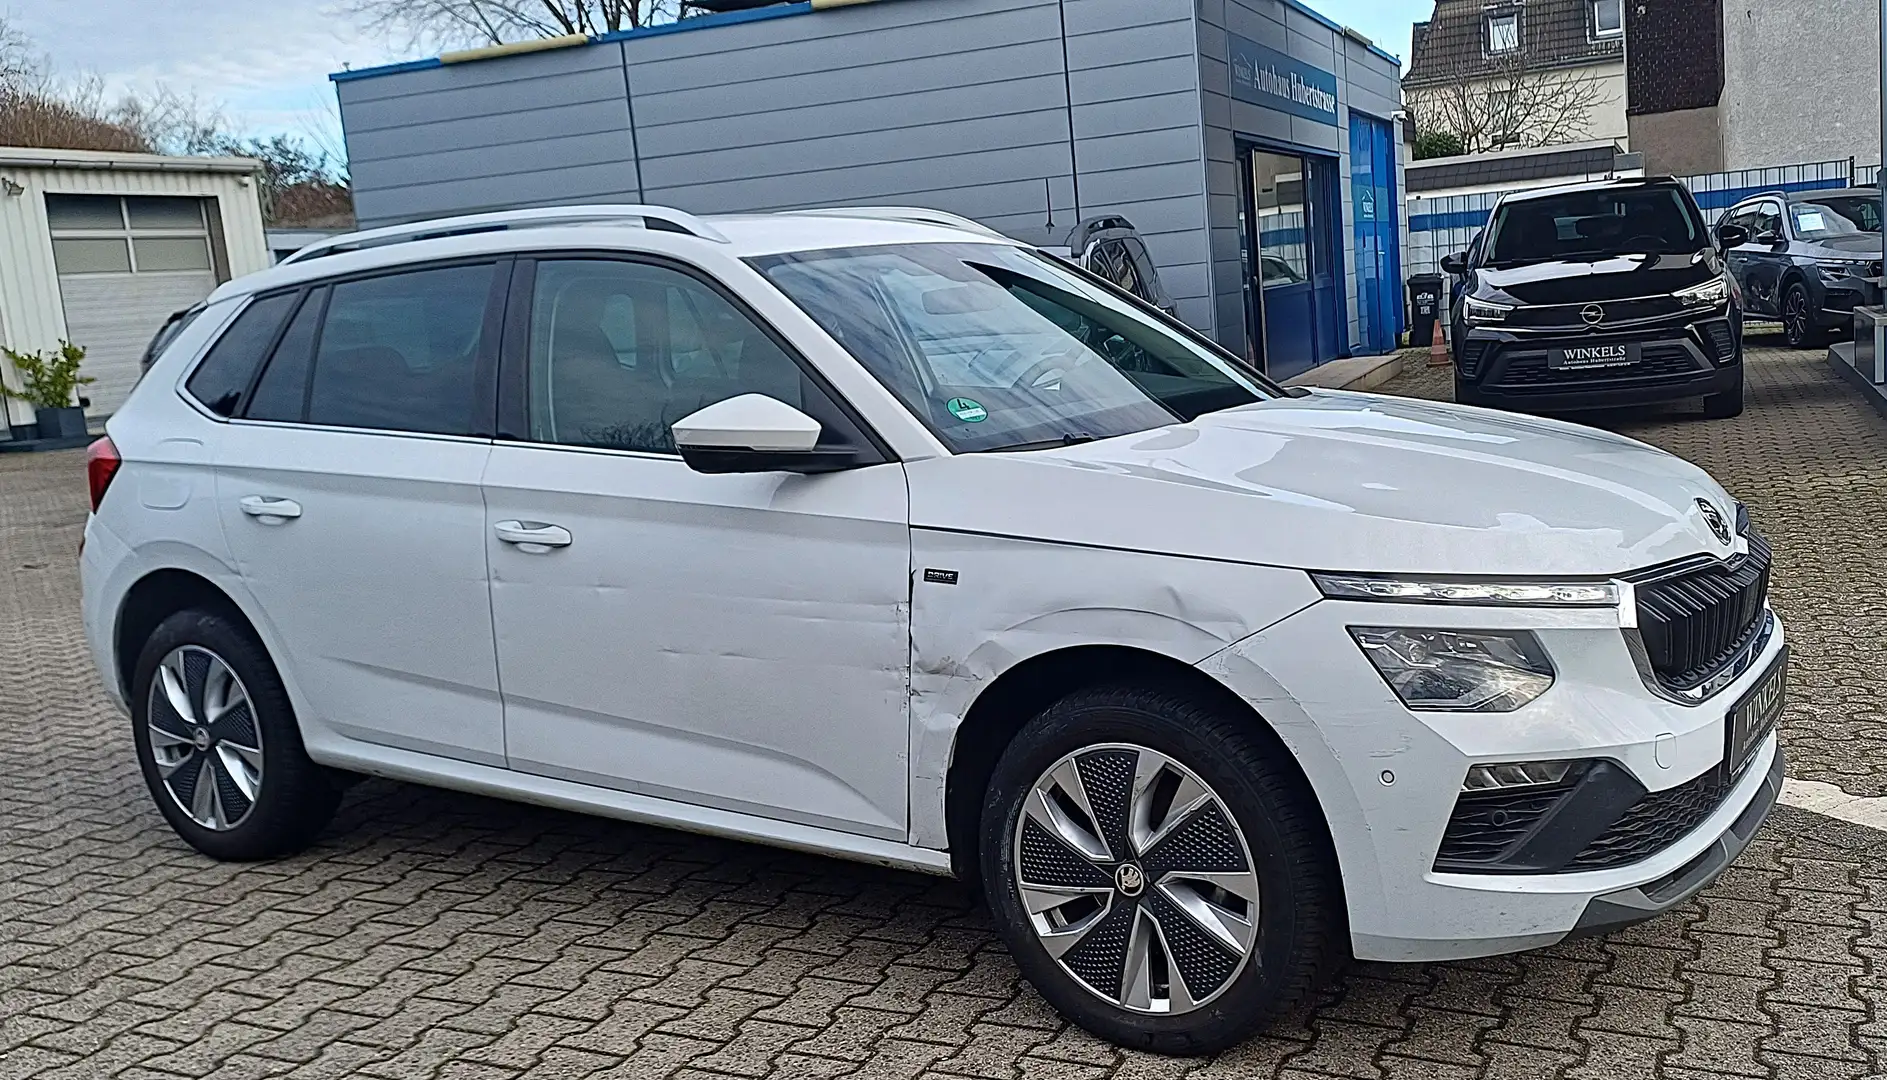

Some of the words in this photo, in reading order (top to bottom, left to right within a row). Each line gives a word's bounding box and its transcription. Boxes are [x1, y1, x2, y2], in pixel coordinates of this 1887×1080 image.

[1254, 57, 1290, 100] Autohaus
[1290, 72, 1335, 114] Hubertstrasse
[1563, 345, 1626, 360] WINKELS
[956, 398, 970, 410] 4
[927, 571, 954, 580] DRIVE
